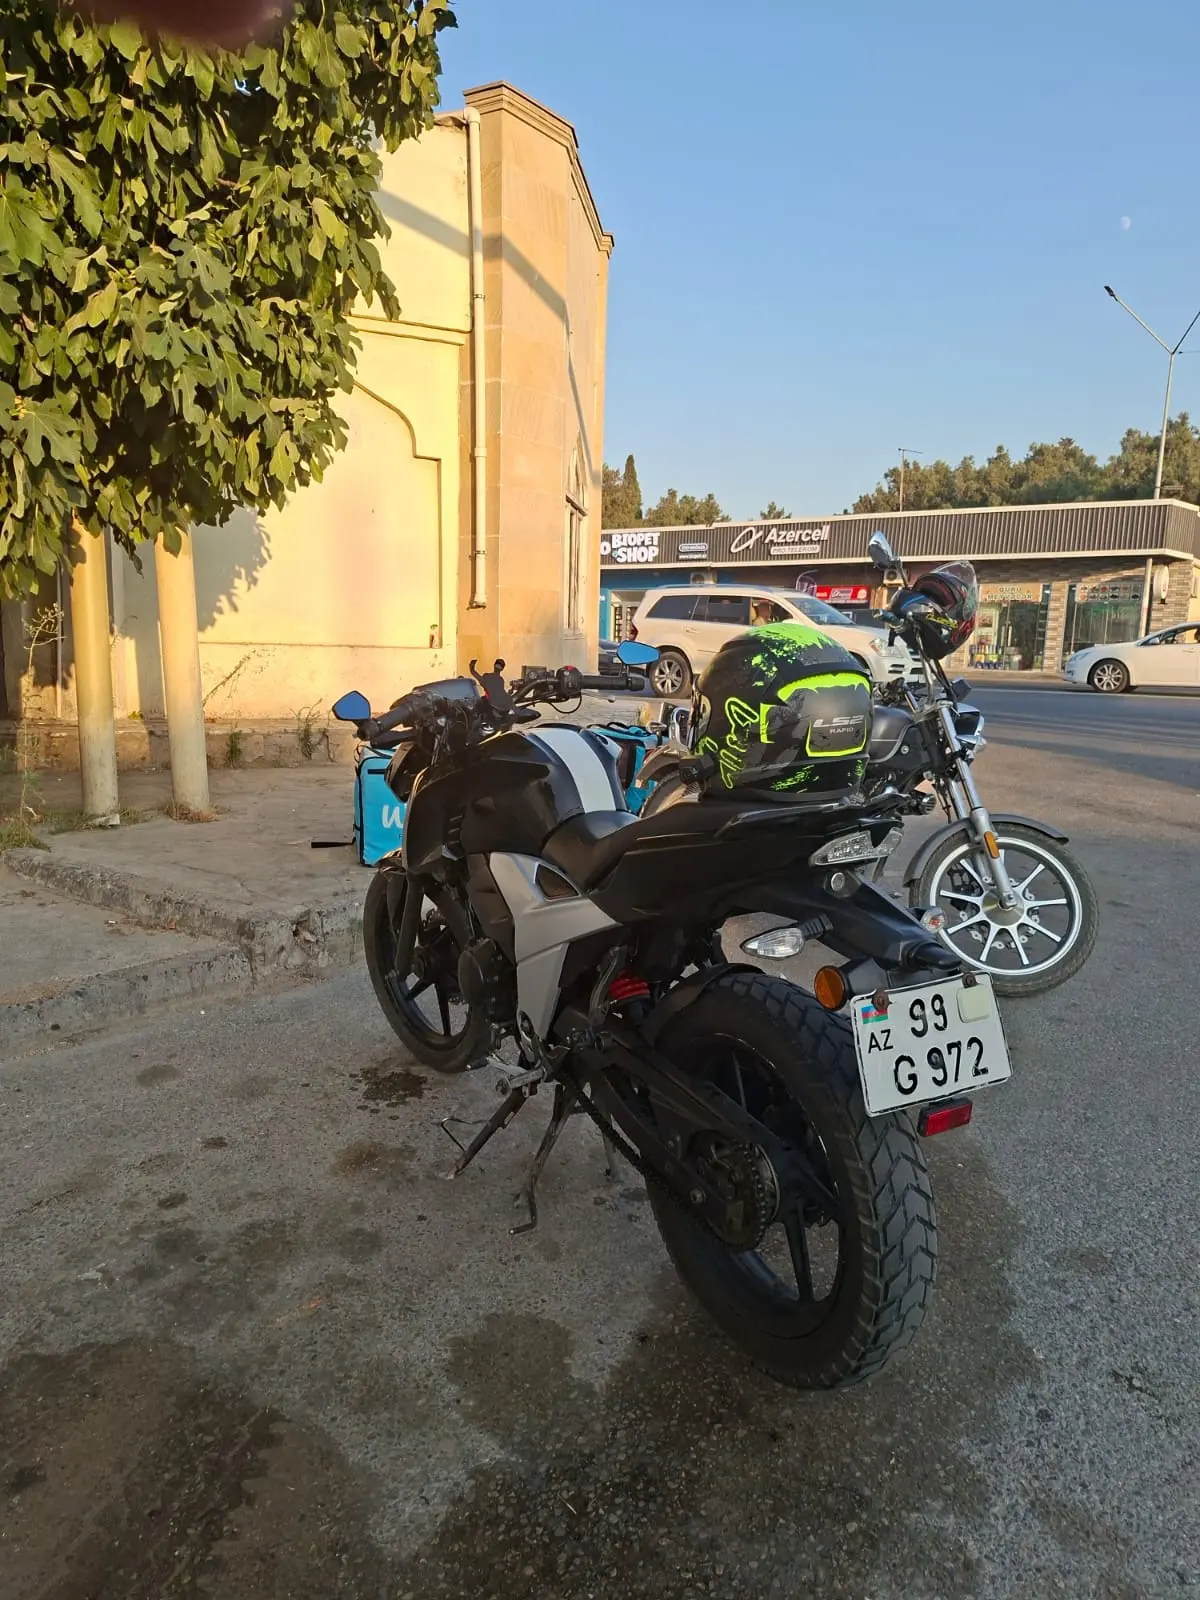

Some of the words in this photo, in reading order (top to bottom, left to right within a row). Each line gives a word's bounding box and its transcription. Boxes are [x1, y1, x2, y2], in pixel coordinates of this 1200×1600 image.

[611, 532, 660, 548] BIOPET
[764, 525, 830, 543] Azercell
[617, 546, 659, 563] SHOP
[813, 714, 865, 728] LS2
[909, 993, 948, 1038] 99
[867, 1028, 893, 1054] AZ
[893, 1054, 918, 1095] G
[926, 1036, 989, 1087] 972
